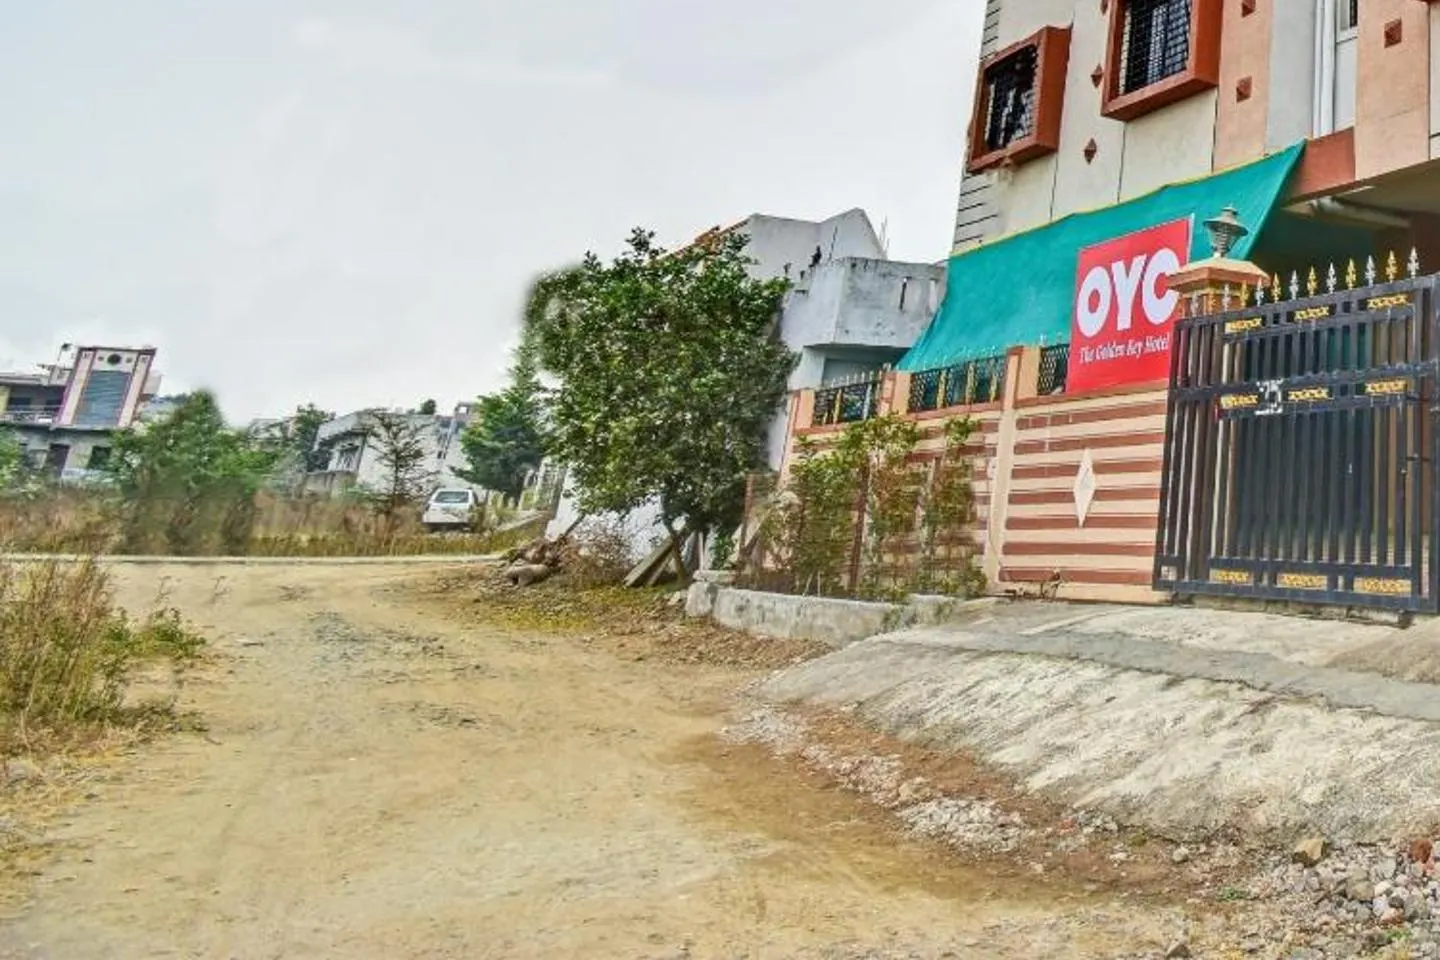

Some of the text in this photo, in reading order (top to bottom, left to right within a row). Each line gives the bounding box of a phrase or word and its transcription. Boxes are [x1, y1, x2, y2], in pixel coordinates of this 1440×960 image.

[1080, 345, 1096, 364] The
[1096, 341, 1125, 361] Golden
[1143, 332, 1170, 353] Hotel
